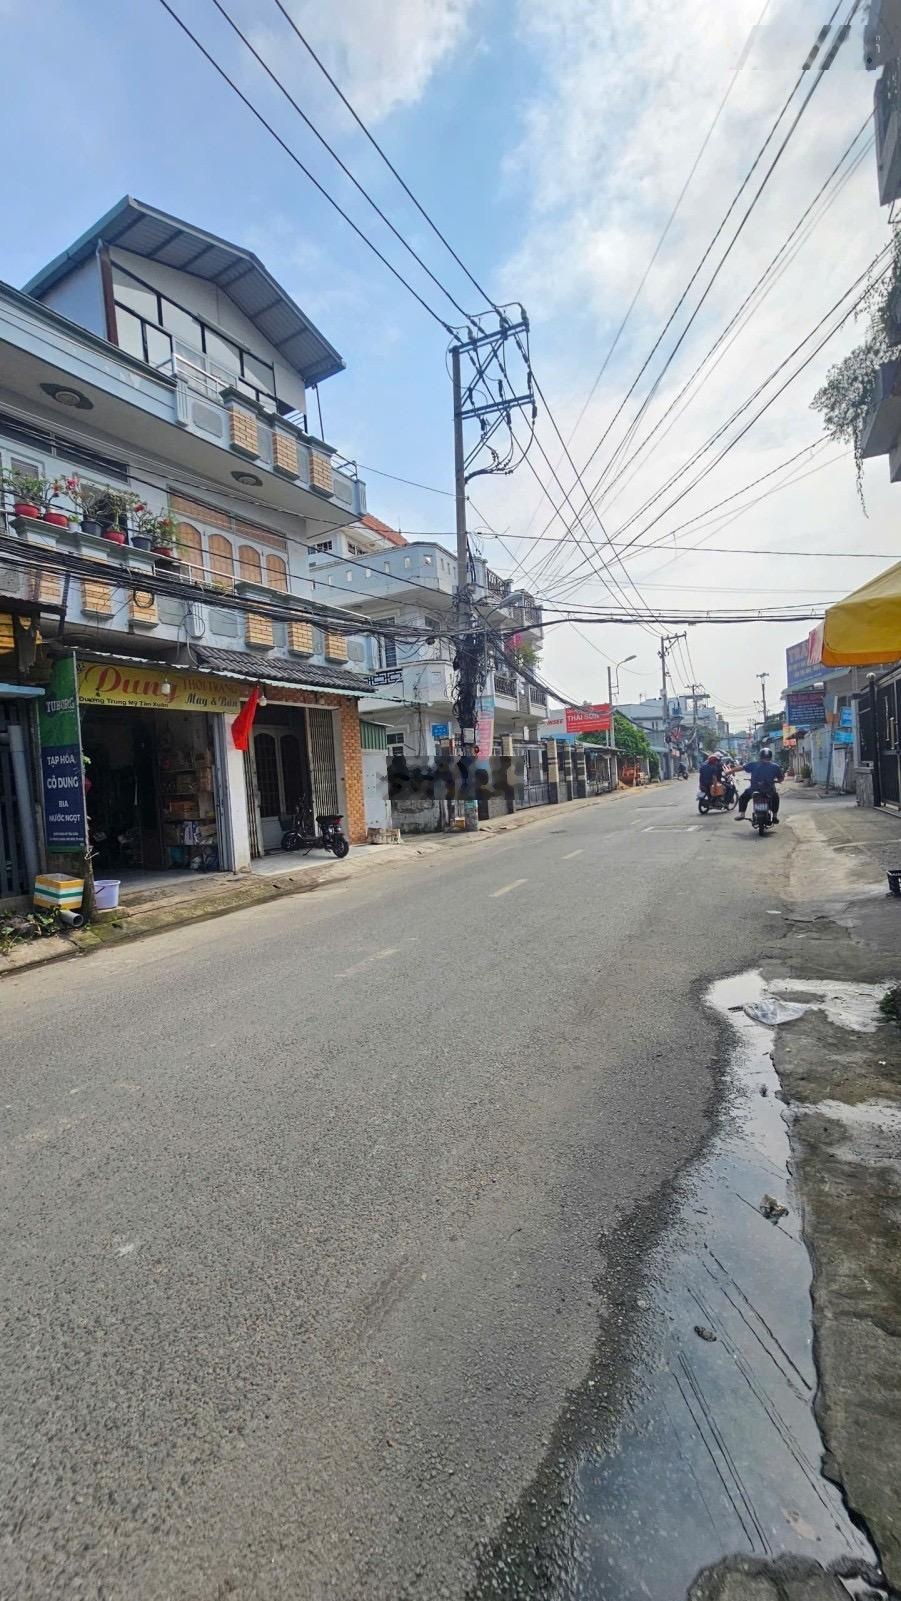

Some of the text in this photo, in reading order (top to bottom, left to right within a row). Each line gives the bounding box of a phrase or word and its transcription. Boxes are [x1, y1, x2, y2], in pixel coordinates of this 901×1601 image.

[46, 698, 76, 713] TUBORG
[210, 696, 217, 706] &
[47, 756, 60, 768] TẠP
[58, 776, 79, 789] DUNG
[58, 800, 69, 808] BIA
